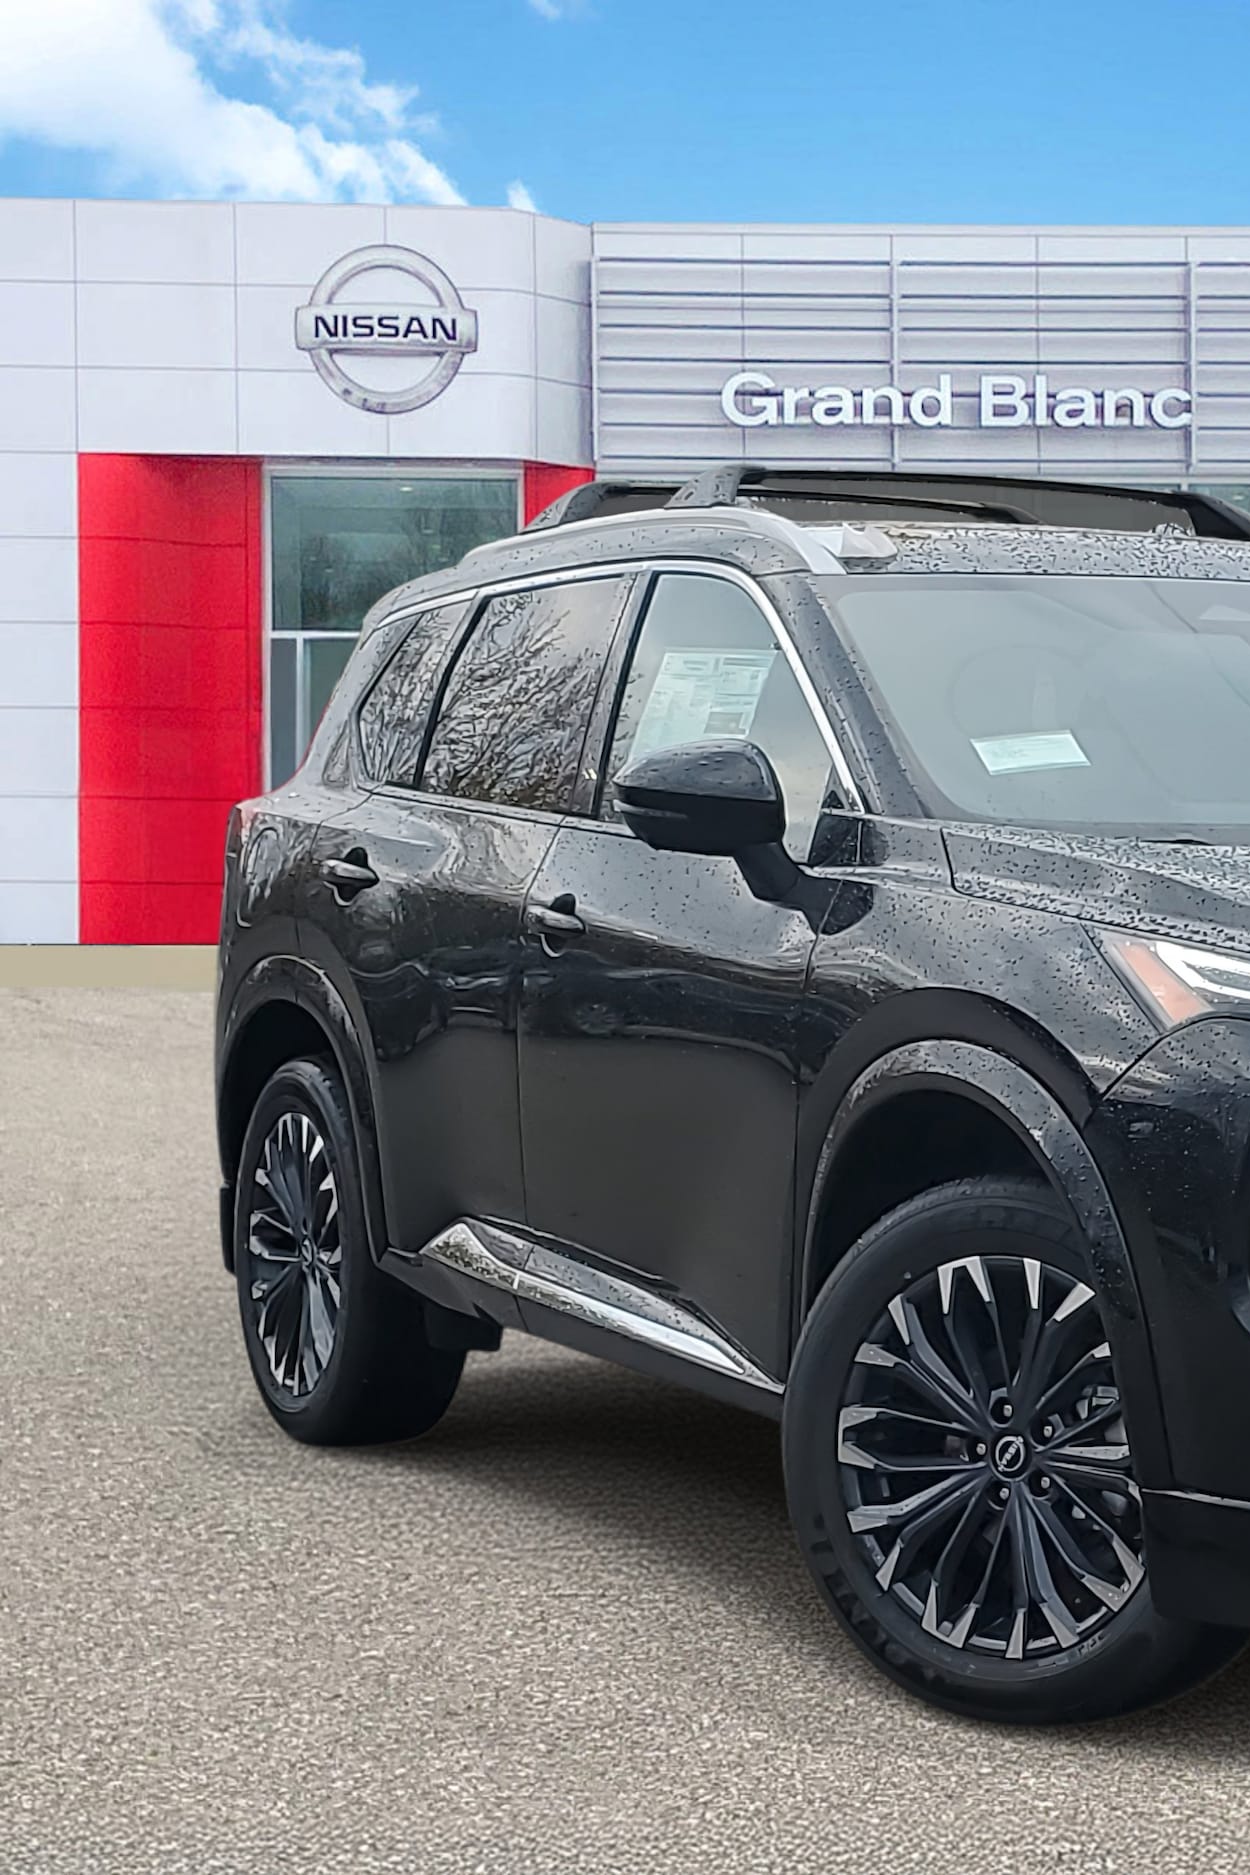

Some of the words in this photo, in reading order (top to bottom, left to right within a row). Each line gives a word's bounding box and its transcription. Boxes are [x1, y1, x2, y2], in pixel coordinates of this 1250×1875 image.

[313, 314, 458, 341] NISSAN
[721, 371, 952, 427] Grand
[979, 374, 1193, 428] Blanc
